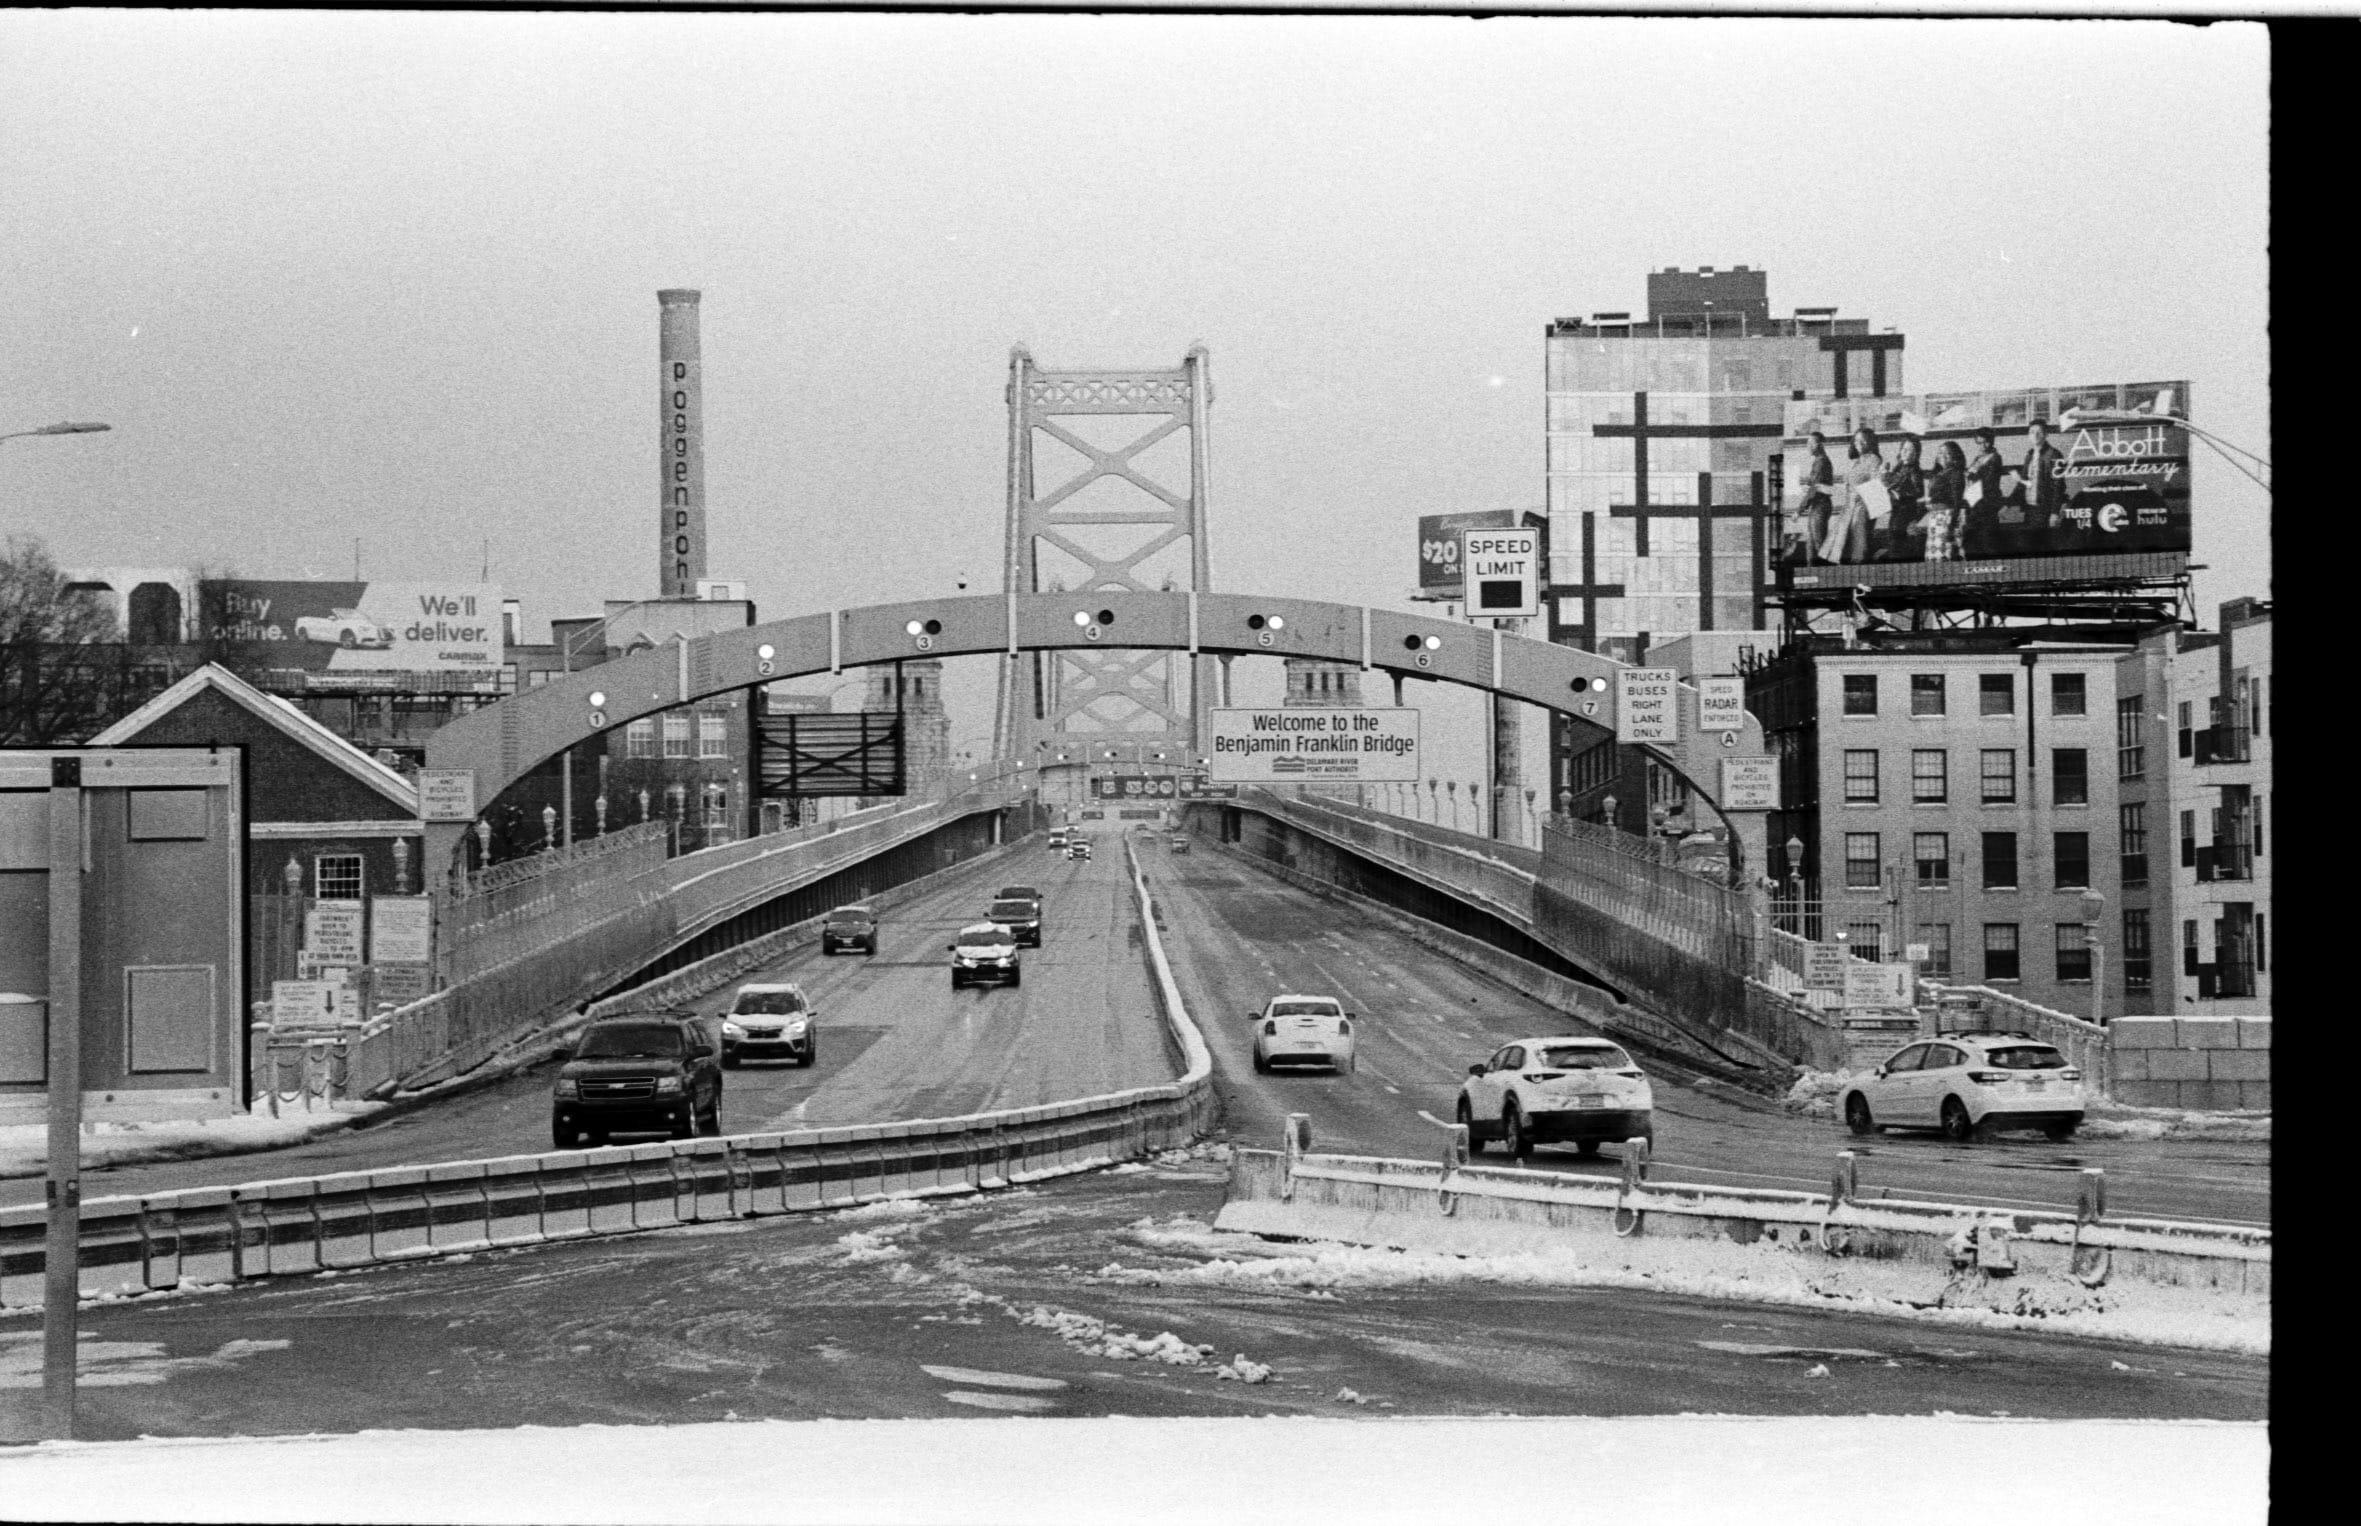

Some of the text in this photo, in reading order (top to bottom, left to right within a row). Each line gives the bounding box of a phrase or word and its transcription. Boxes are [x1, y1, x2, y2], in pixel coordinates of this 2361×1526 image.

[2068, 425, 2167, 460] Abbott
[2051, 458, 2180, 482] Elementary
[2064, 507, 2092, 519] TUES
[2137, 514, 2167, 526] hulu
[1422, 539, 1458, 564] $20
[1470, 540, 1532, 554] SPEED
[1476, 561, 1525, 575] LIMIT
[419, 595, 476, 616] We'll
[404, 621, 488, 642] deliver.
[1087, 627, 1098, 638] 4
[920, 637, 929, 648] 3
[1262, 634, 1271, 644] 5
[1418, 655, 1428, 666] 6
[761, 662, 771, 673] 2
[1624, 672, 1671, 682] TRUCKS
[1627, 686, 1668, 696] BUSES
[1585, 703, 1595, 713] 7
[1632, 700, 1663, 710] RIGHT
[1704, 699, 1738, 709] RADAR
[593, 714, 600, 726] 1
[1253, 714, 1379, 731] Welcome to the
[1632, 714, 1663, 724] LANE
[1633, 729, 1663, 738] ONLY
[1724, 733, 1735, 744] A
[1215, 734, 1415, 756] Benjamin Franklin Bridge
